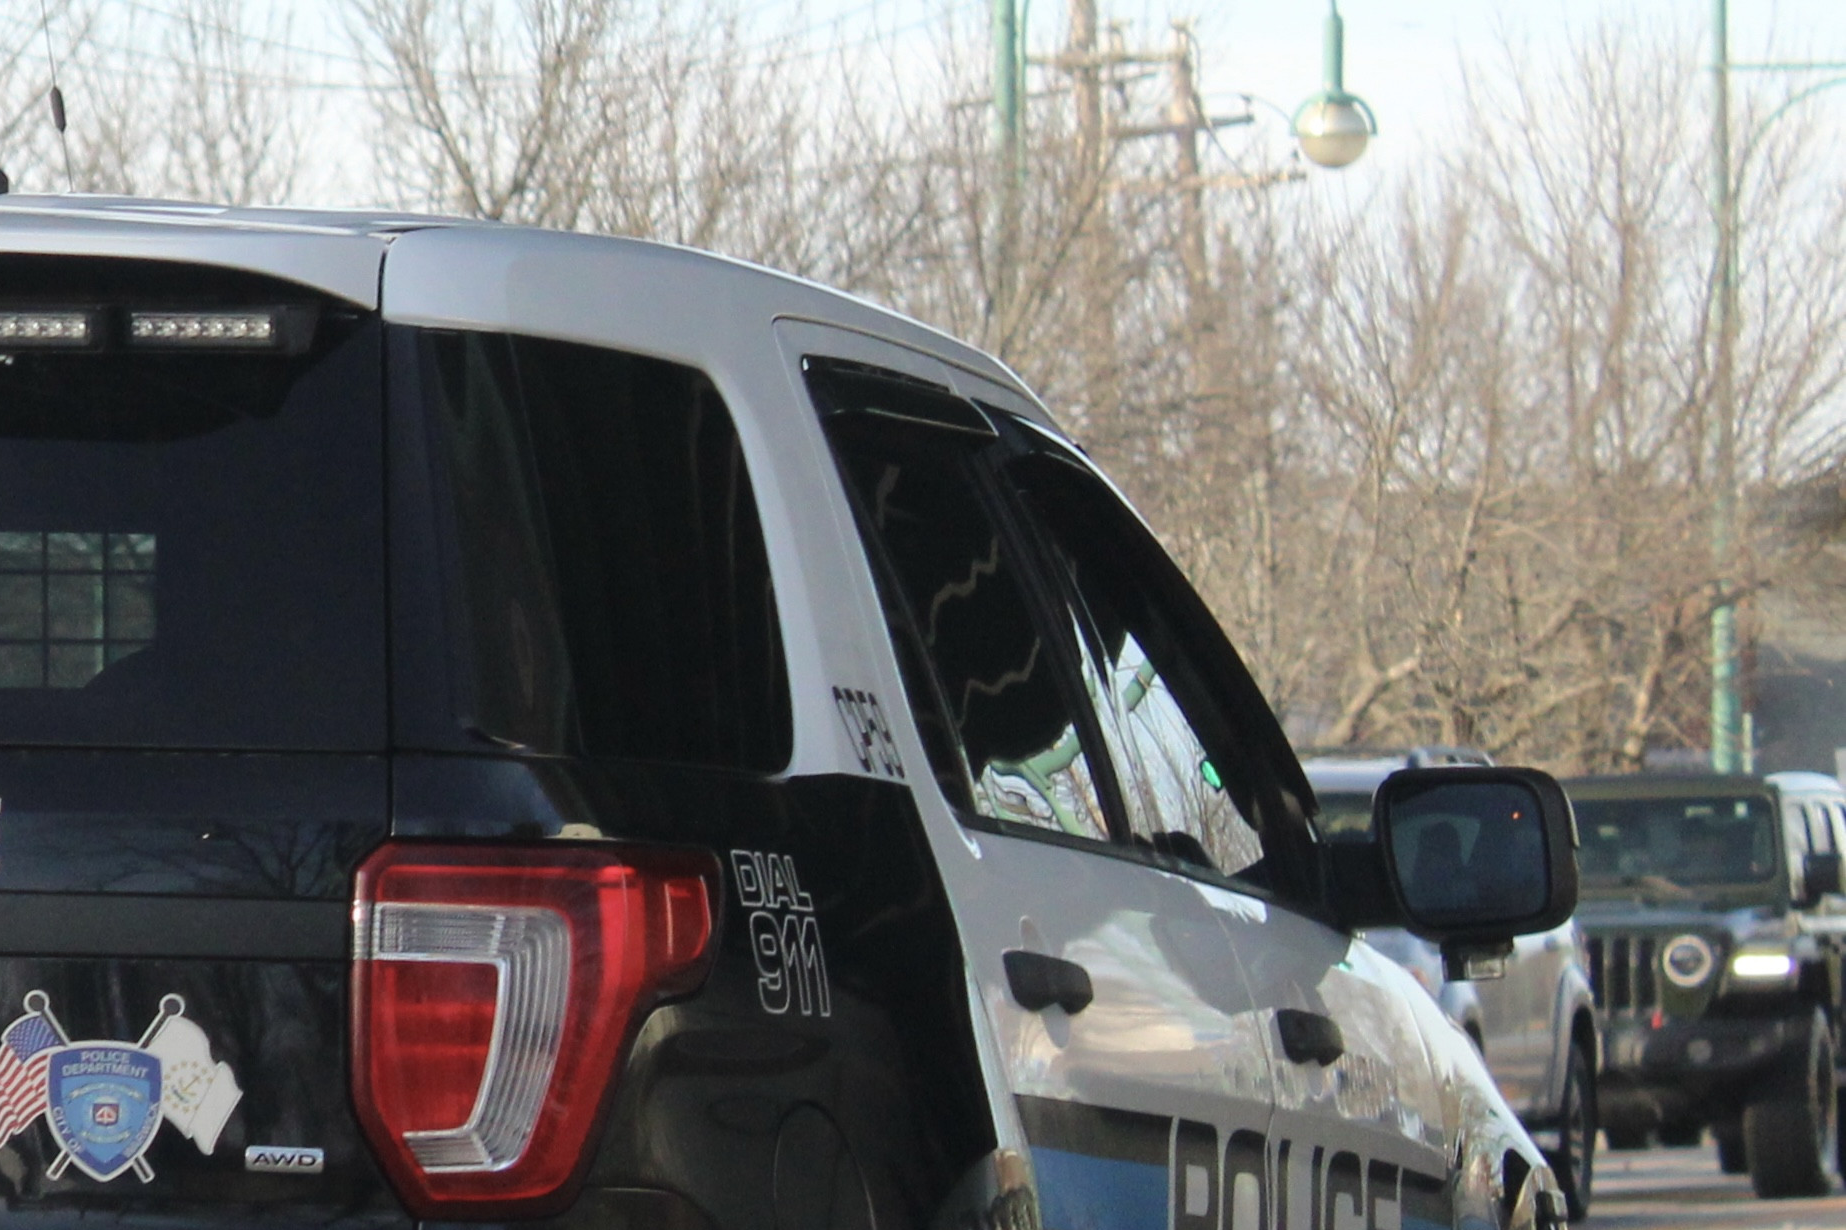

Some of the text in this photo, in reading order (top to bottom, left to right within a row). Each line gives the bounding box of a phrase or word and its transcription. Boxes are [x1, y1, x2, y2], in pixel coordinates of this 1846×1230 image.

[730, 848, 814, 912] DIAL
[749, 910, 832, 1017] 911
[80, 1050, 131, 1063] POLICE
[61, 1062, 149, 1079] DEPARTMENT
[252, 1153, 318, 1167] AWD
